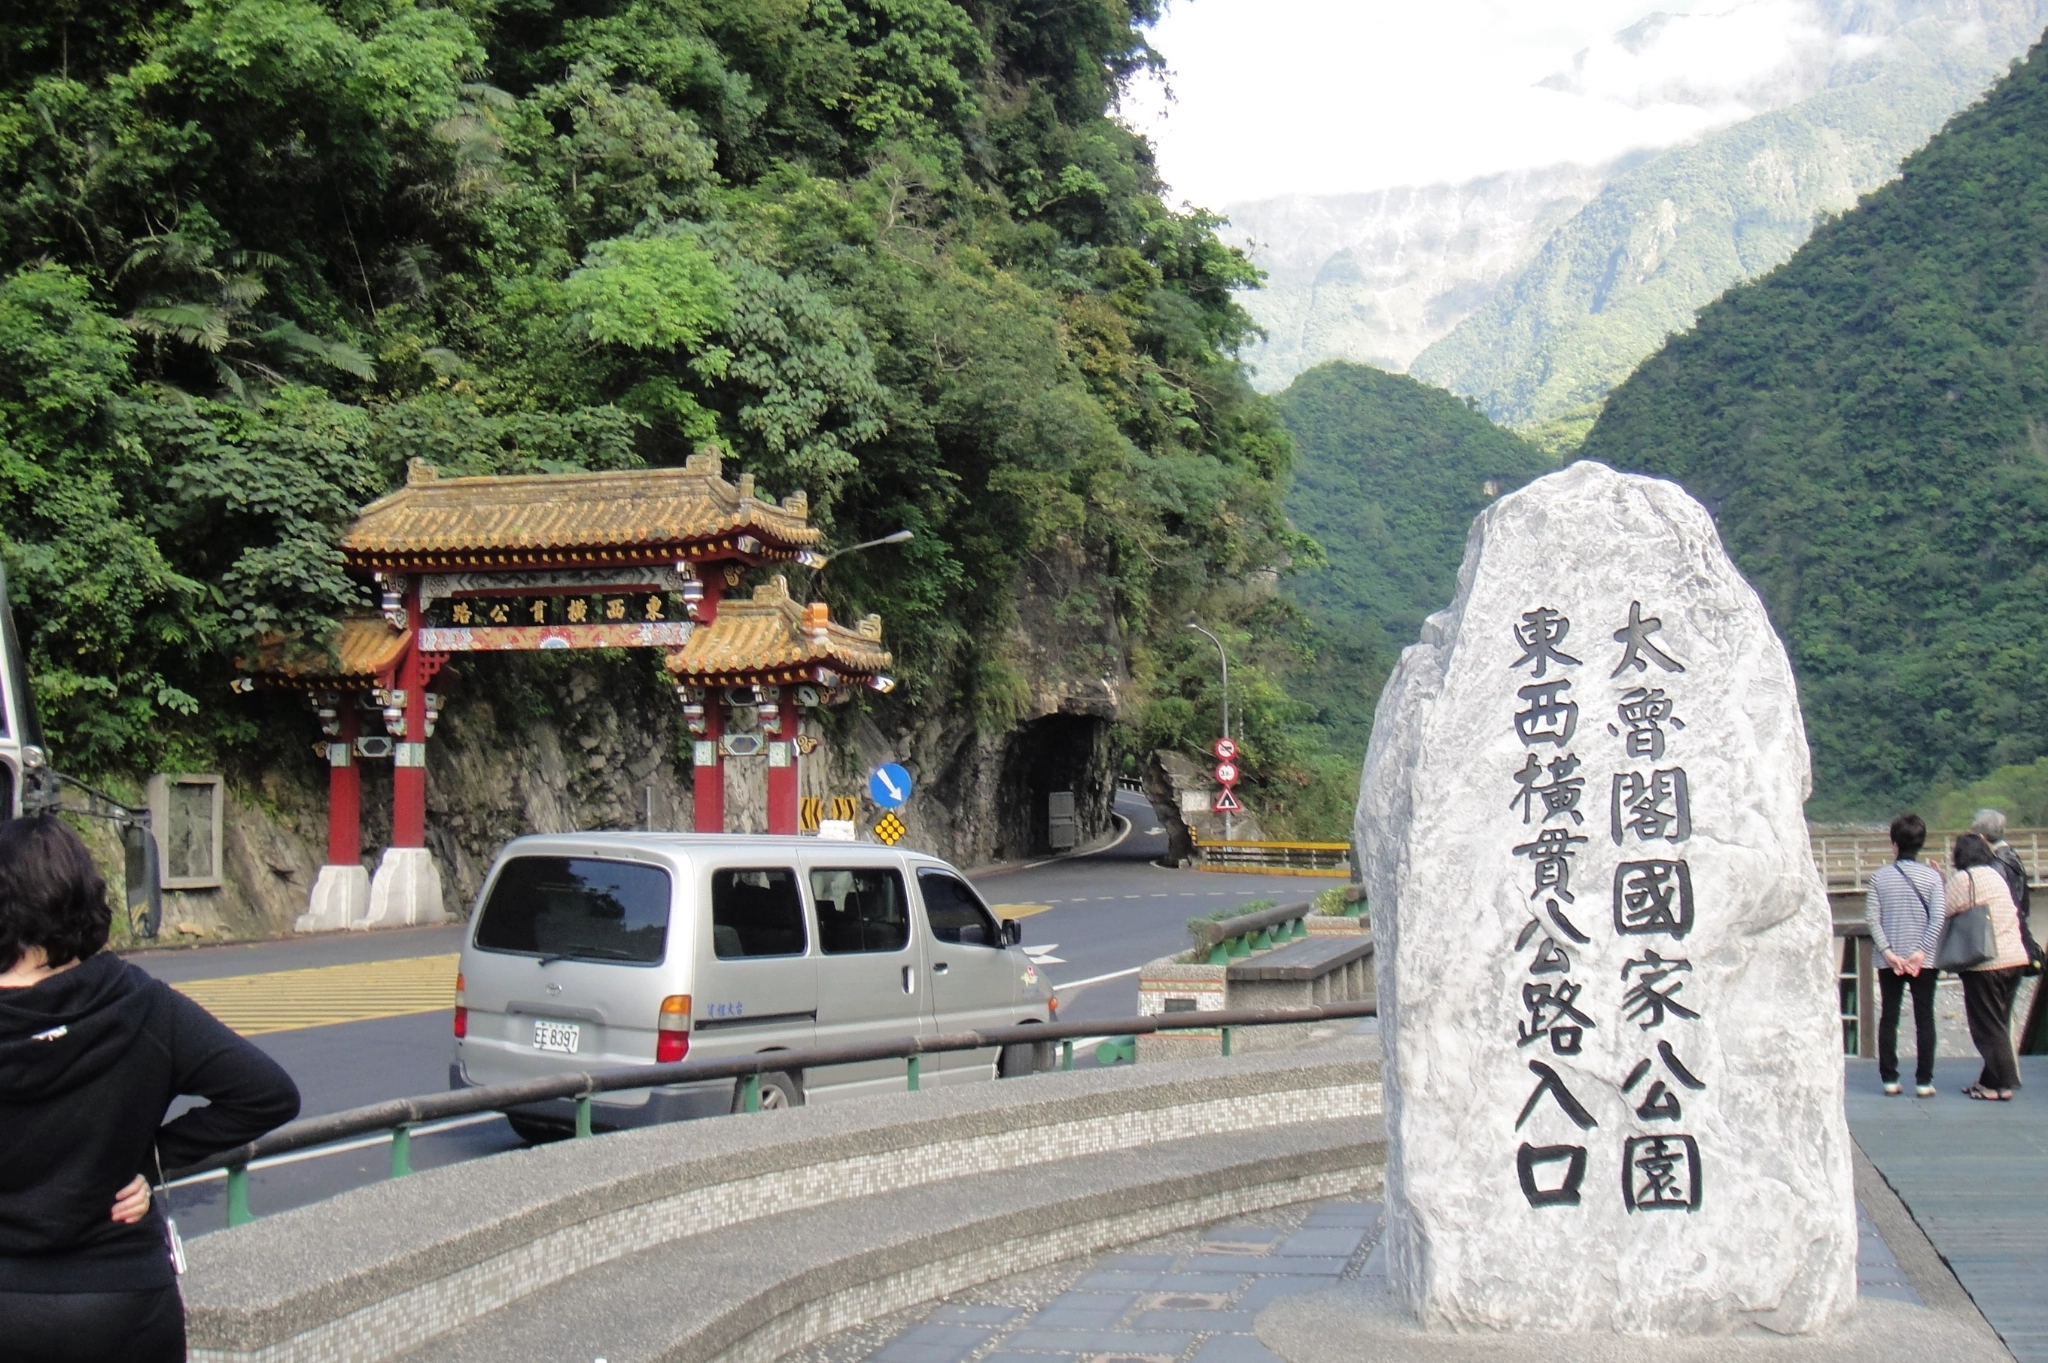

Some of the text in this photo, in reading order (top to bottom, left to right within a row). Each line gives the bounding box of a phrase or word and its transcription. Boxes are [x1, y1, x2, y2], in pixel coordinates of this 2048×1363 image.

[1508, 606, 1599, 1210] 東西橫貫公路入口
[1605, 600, 1706, 1215] 太魯閣國家公園
